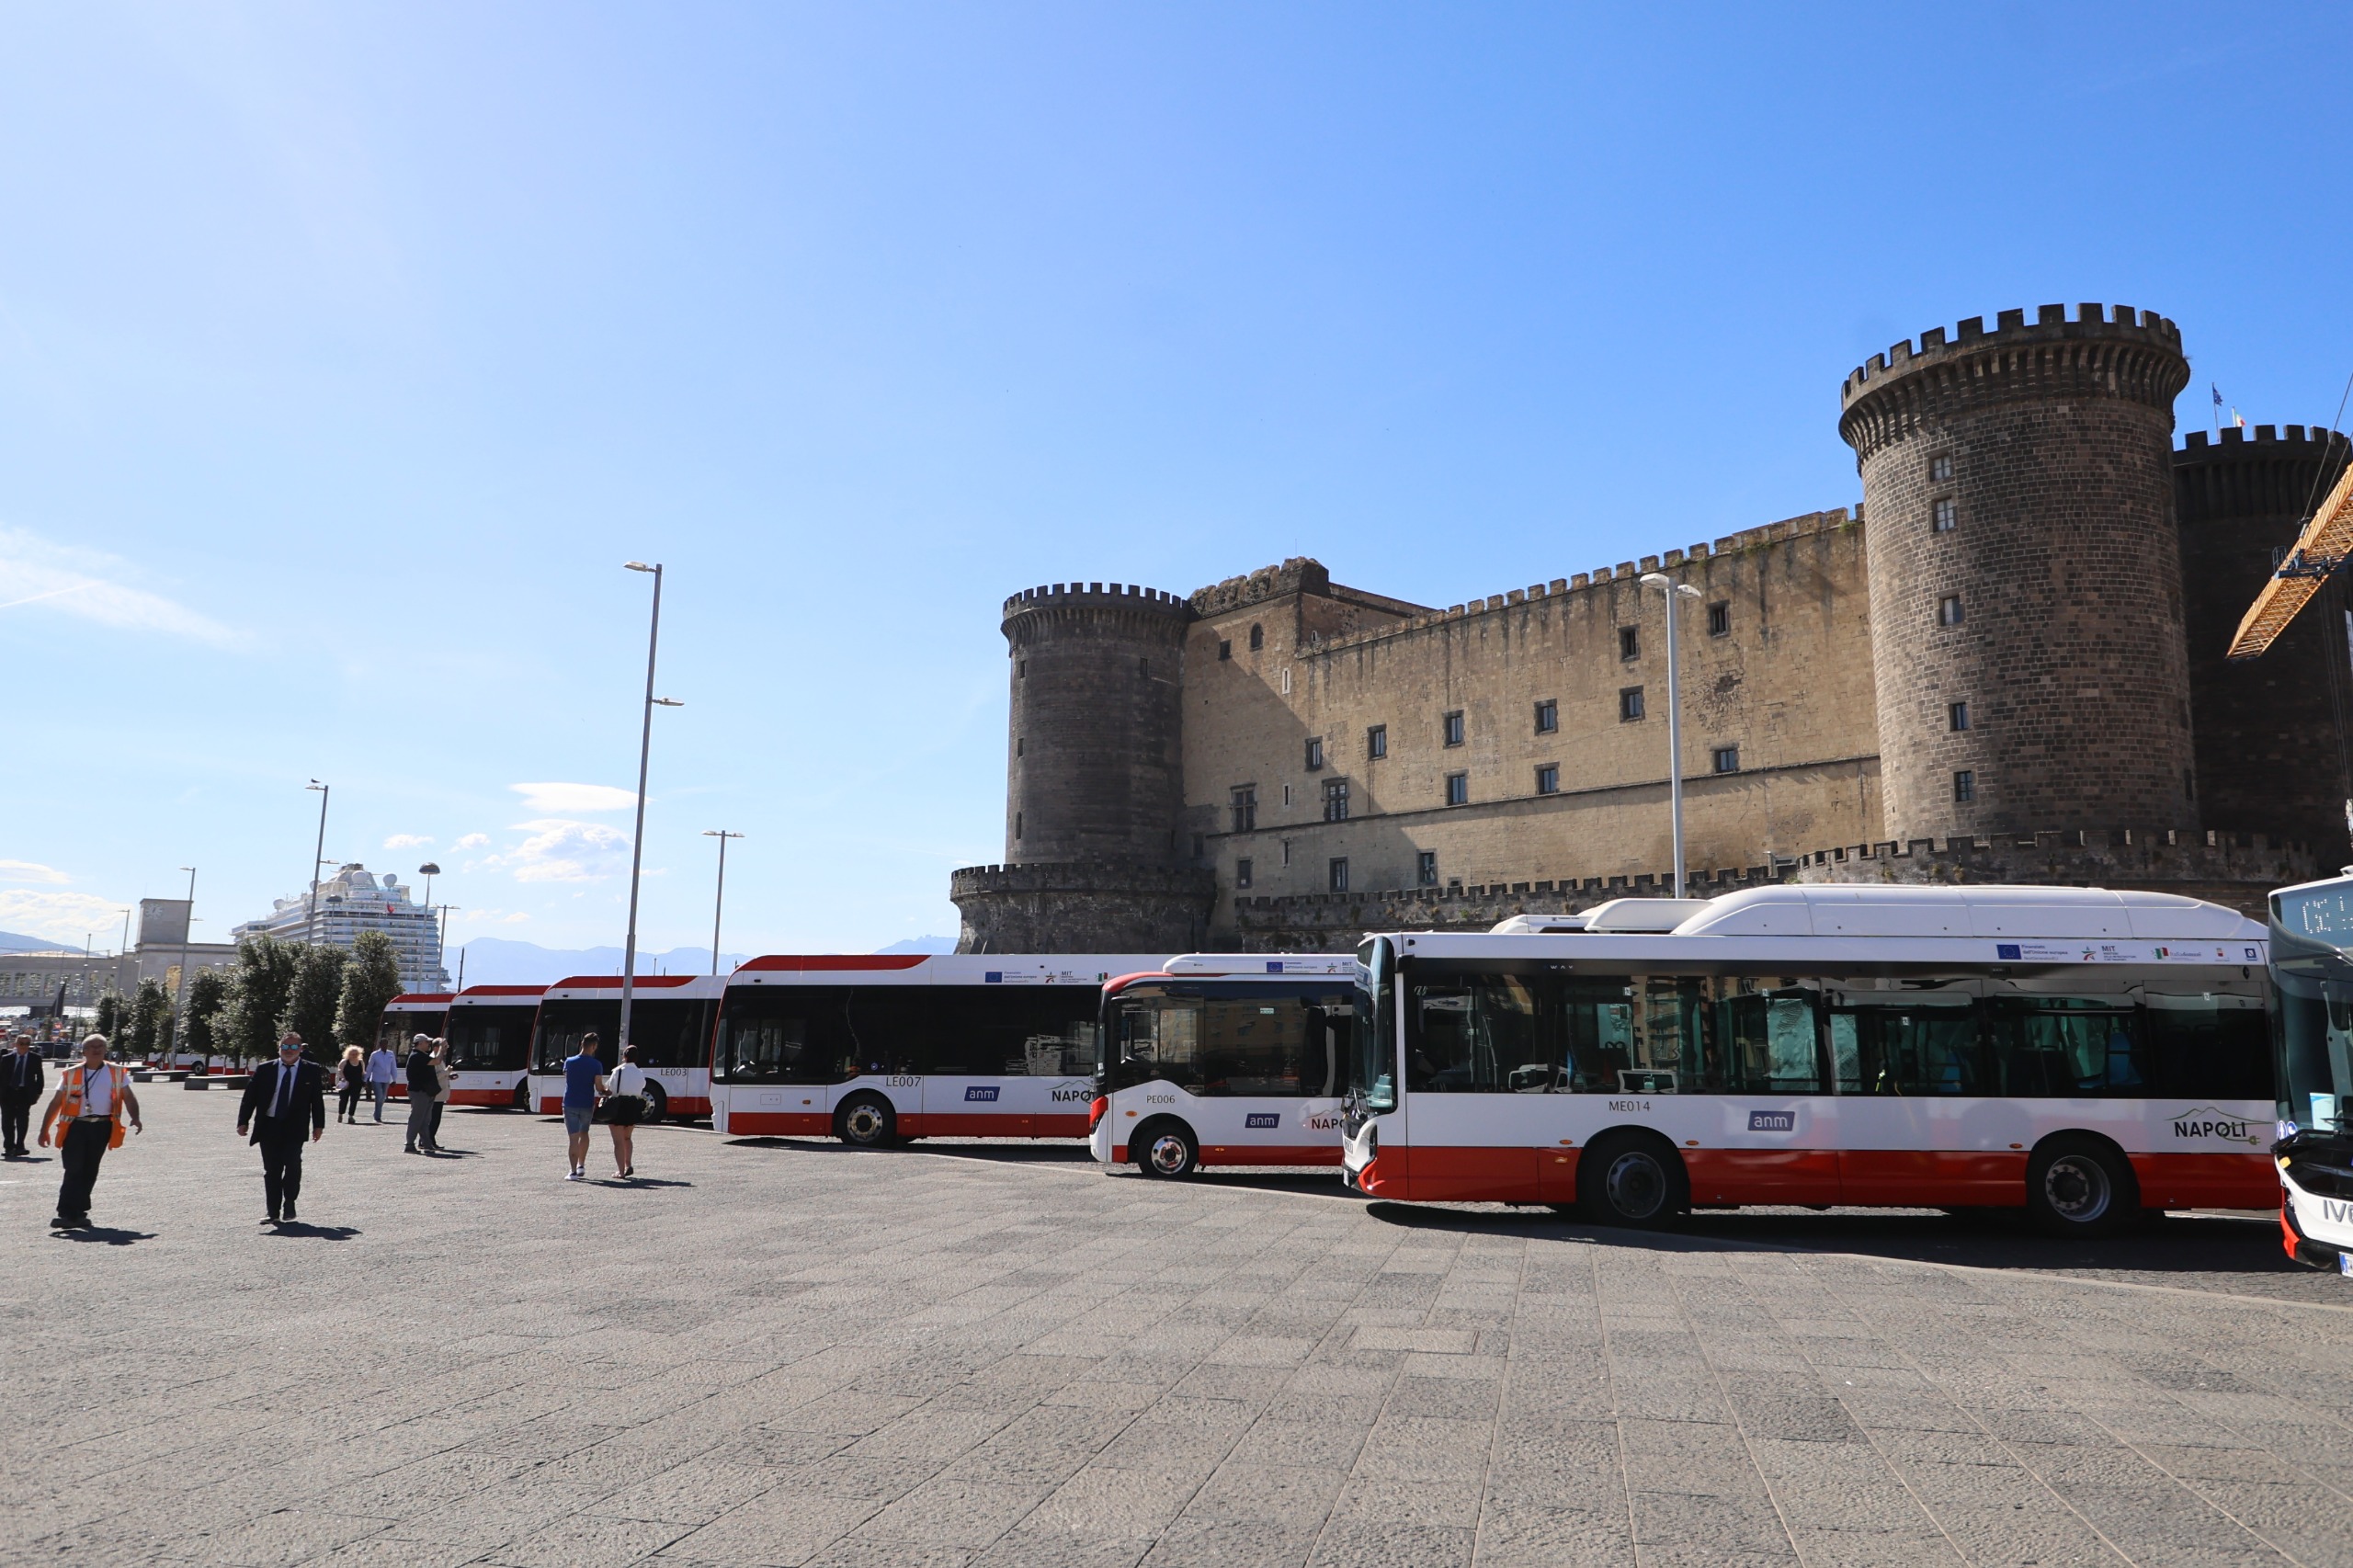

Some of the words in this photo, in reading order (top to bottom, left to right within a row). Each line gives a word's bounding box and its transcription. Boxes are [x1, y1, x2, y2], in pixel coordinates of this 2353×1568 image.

[660, 1068, 688, 1076] LE003
[885, 1076, 922, 1087] LE007
[968, 1088, 995, 1100] anm
[1146, 1095, 1176, 1104] PE006
[1608, 1100, 1651, 1112] ME014
[1249, 1116, 1276, 1127] anm
[1311, 1118, 1343, 1130] NAP
[1753, 1115, 1789, 1129] anm
[2173, 1121, 2246, 1138] NAPOLI
